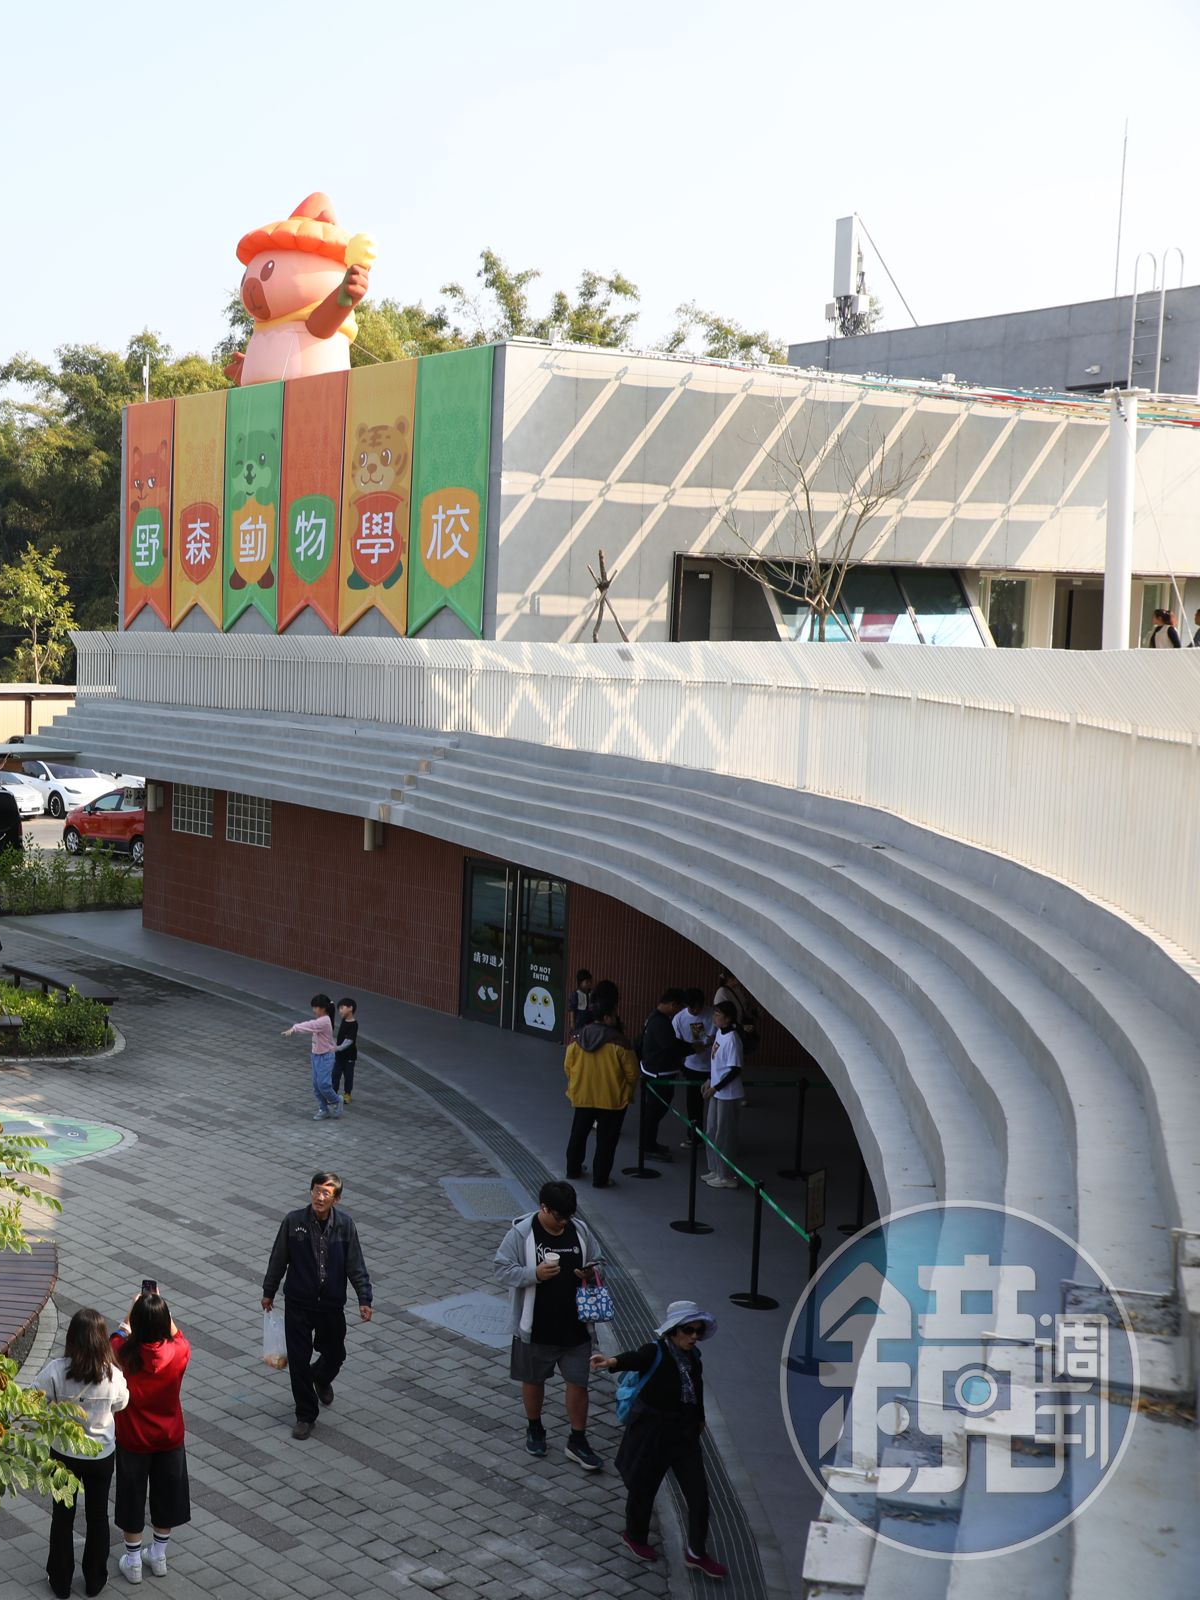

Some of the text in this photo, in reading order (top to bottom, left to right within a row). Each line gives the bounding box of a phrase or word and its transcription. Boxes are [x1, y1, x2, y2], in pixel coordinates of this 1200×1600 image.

[135, 504, 470, 567] 野森動物學校
[530, 964, 551, 974] DO NOT
[532, 972, 549, 982] ENTER
